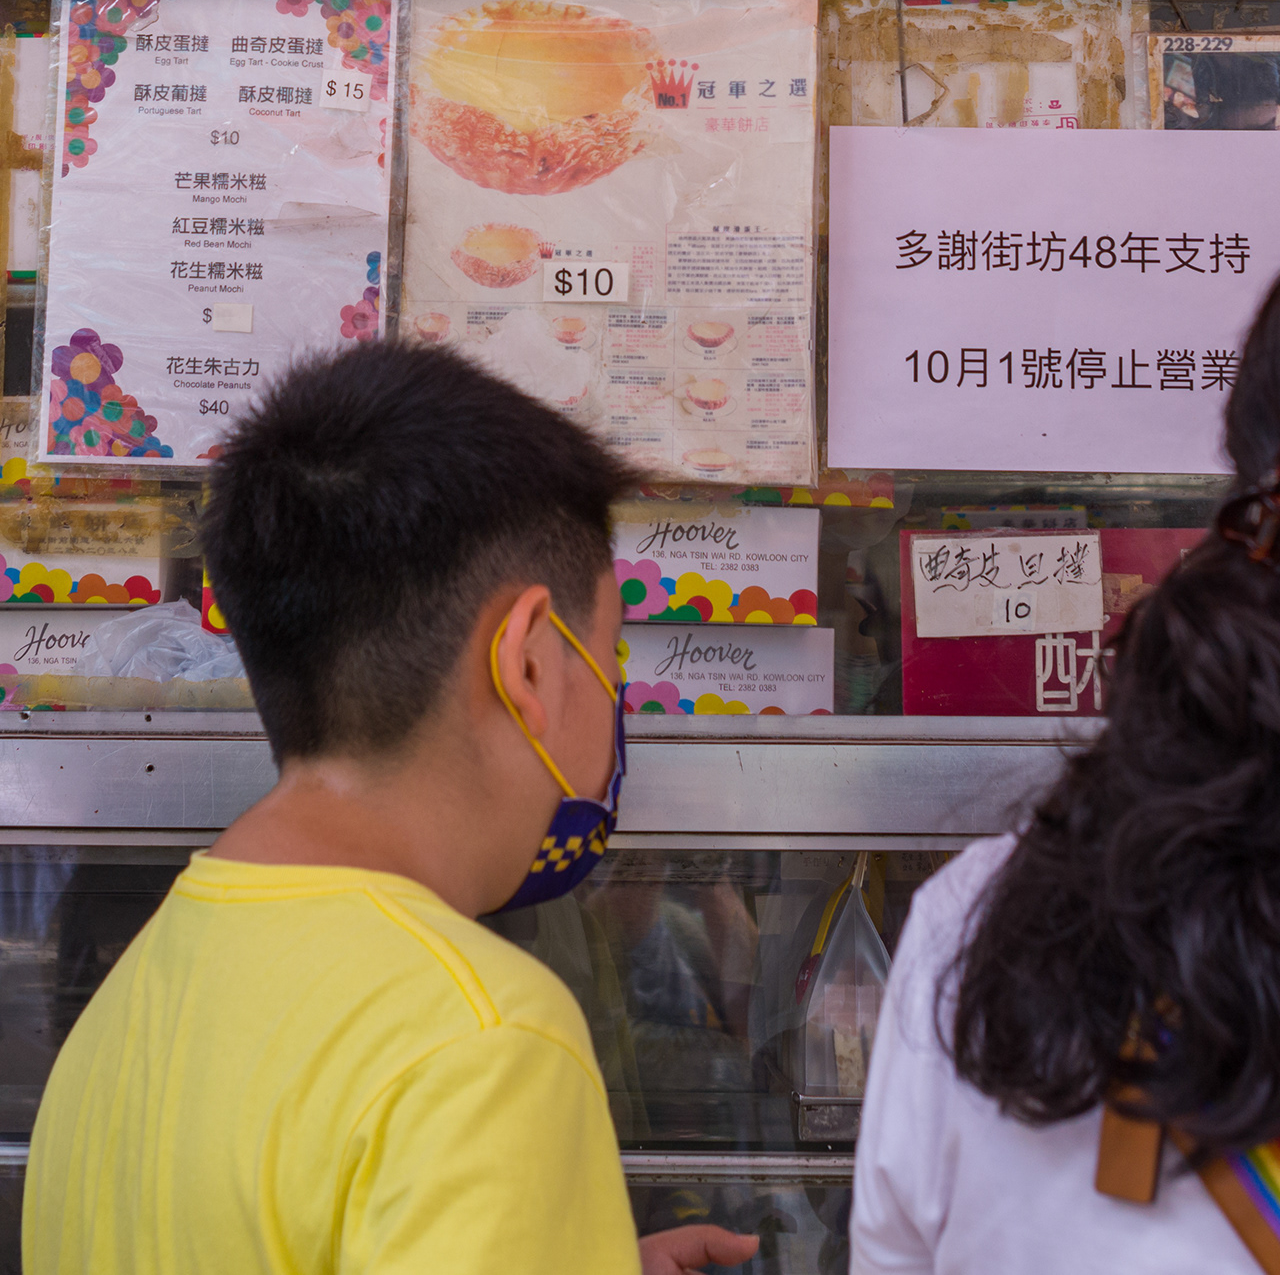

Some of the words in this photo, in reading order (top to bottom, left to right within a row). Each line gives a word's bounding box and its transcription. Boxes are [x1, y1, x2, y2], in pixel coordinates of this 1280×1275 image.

[135, 34, 209, 53] 酥皮蛋撻
[231, 36, 324, 55] 曲奇皮蛋撻
[1163, 37, 1234, 52] 228-229
[154, 56, 172, 66] Egg
[173, 56, 189, 65] Tart
[229, 58, 247, 67] Egg
[248, 58, 264, 66] Tart
[270, 58, 300, 67] Cookie
[301, 59, 324, 68] Crust
[133, 84, 207, 102] 酥皮葡撻
[238, 86, 313, 105] 酥皮椰撻
[344, 82, 364, 99] 15
[697, 78, 808, 99] 冠軍之選
[657, 93, 687, 107] No.1
[138, 106, 184, 116] Portuguese
[185, 107, 202, 115] Tart
[249, 108, 283, 116] Coconut
[285, 109, 301, 117] Tart
[705, 117, 769, 132] 豪華餅店
[210, 130, 240, 145] $10
[175, 172, 267, 190] 芒果糯米糍
[192, 195, 220, 204] Mango
[222, 195, 247, 203] Mochi
[172, 217, 265, 236] 紅豆糯米糍
[203, 240, 225, 248] Bean
[227, 240, 252, 248] Mochi
[895, 229, 1251, 274] 多謝街坊48年支持
[170, 261, 263, 280] 花生糯米糍
[188, 284, 218, 292] Peanut
[219, 285, 244, 293] Mochi
[554, 268, 613, 296] $10
[166, 356, 260, 376] 花生朱古力
[905, 347, 1242, 392] 10月1號停止營業
[173, 380, 215, 389] Chocolate
[217, 380, 252, 389] Peanuts
[199, 398, 229, 415] $40
[636, 521, 739, 554] Hoover
[652, 550, 667, 558] 136,
[670, 551, 687, 559] NGA
[690, 551, 708, 559] TSIN
[710, 552, 726, 560] WAI
[746, 553, 787, 561] KOWLOON
[790, 554, 809, 562] CITY
[700, 562, 718, 570] TEL:
[720, 562, 738, 571] 2382
[741, 563, 760, 571] 0383
[1005, 598, 1031, 623] 10
[654, 633, 757, 676] Hoover
[688, 672, 706, 680] NGA
[708, 672, 725, 680] TSIN
[728, 672, 744, 681] WAI
[763, 673, 805, 681] KOWLOON
[807, 674, 826, 682] CITY
[718, 683, 737, 692] TEL:
[738, 683, 757, 692] 2382
[759, 684, 777, 692] 0383
